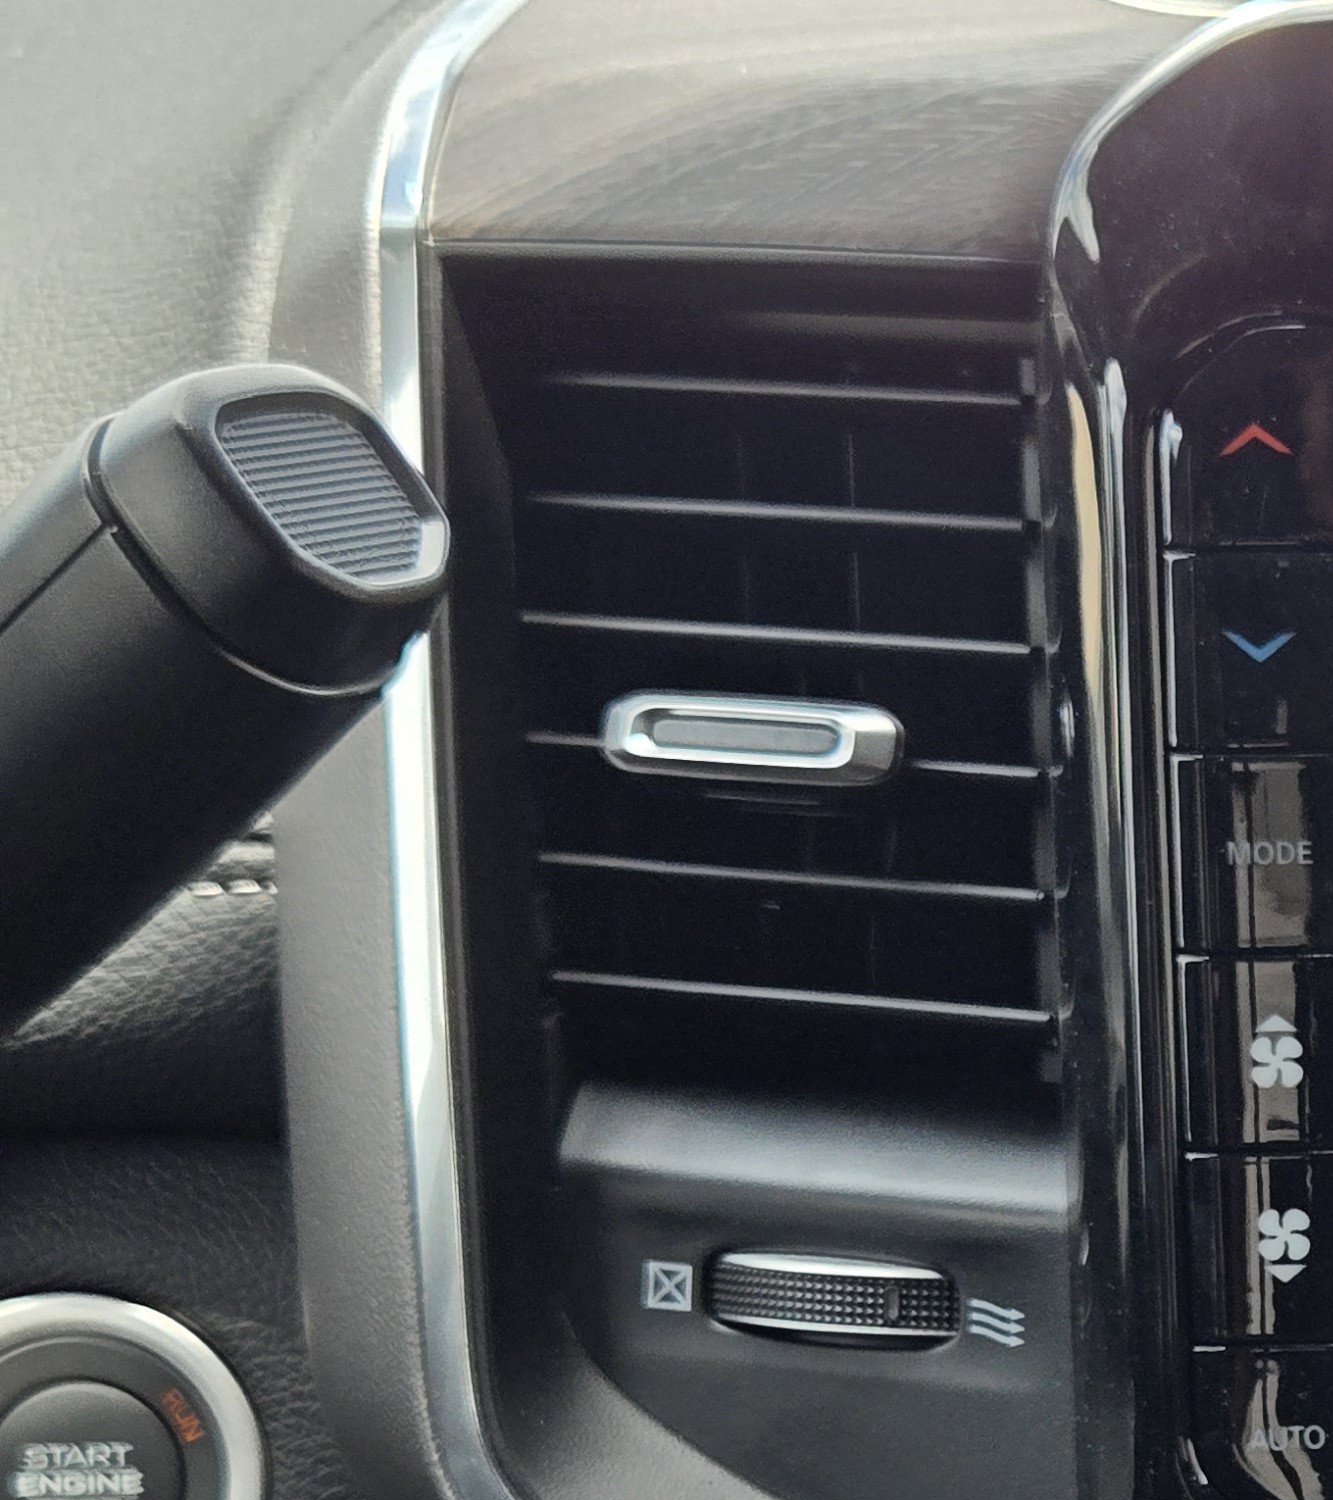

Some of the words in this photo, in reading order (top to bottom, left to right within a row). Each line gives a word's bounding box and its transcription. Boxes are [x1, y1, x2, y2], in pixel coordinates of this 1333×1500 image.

[1226, 840, 1314, 866] MODE
[1245, 1425, 1326, 1451] AUTO
[22, 1442, 133, 1470] START
[12, 1468, 145, 1497] ENGINE
